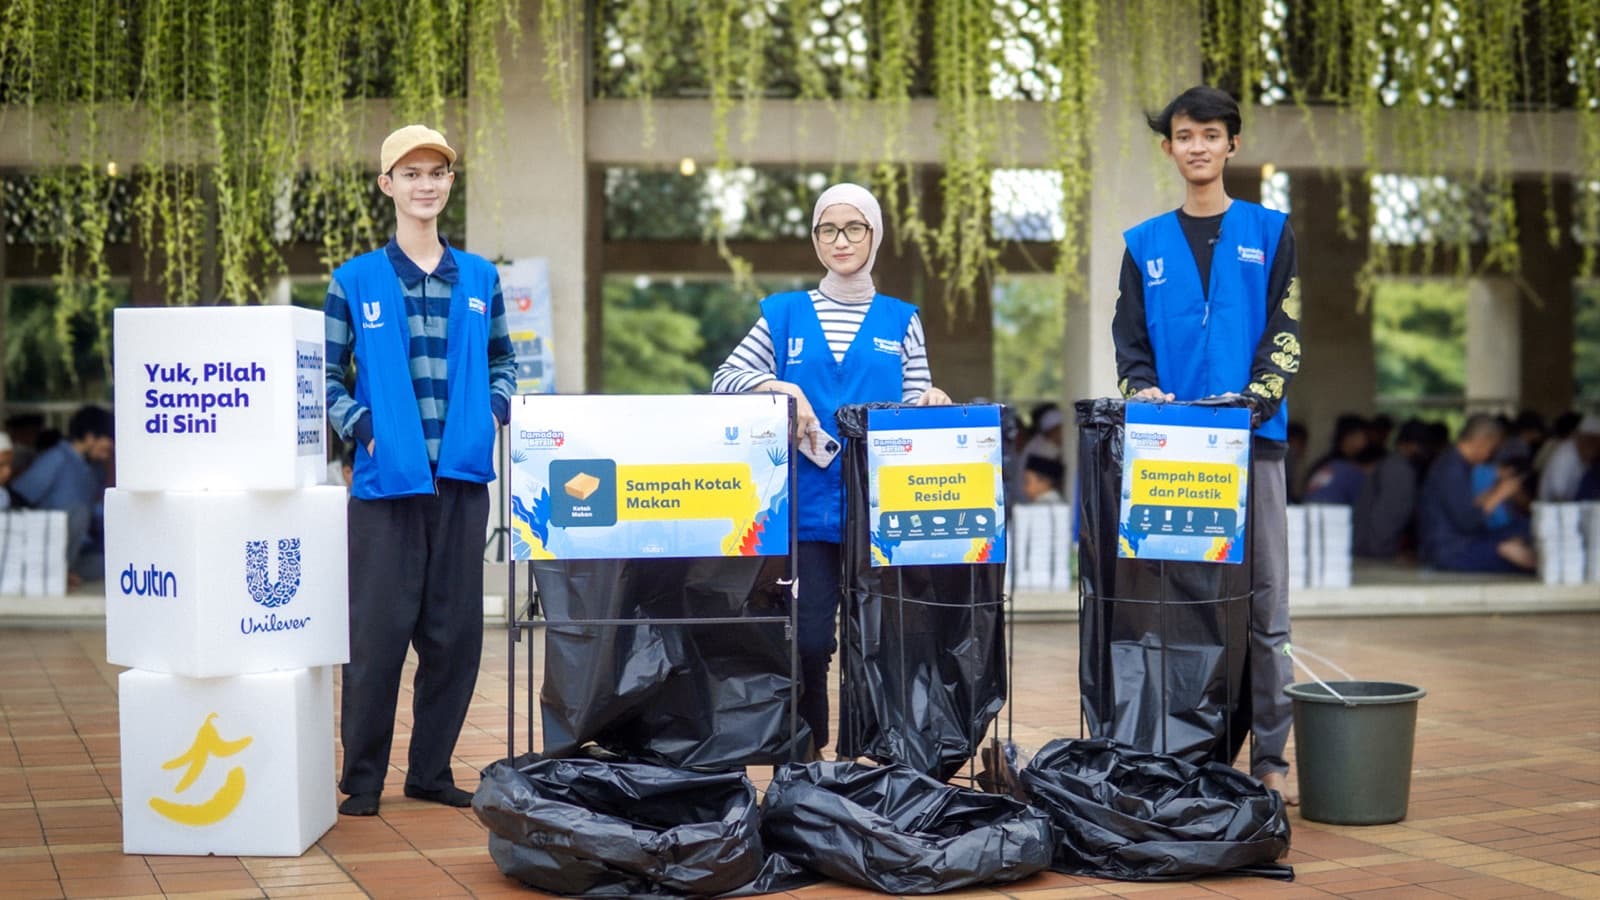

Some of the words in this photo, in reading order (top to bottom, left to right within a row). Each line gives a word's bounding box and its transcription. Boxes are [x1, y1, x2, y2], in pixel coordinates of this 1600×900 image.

[144, 362, 198, 385] Yuk,
[203, 362, 266, 382] Pilah
[145, 388, 250, 412] Sampah
[145, 413, 168, 433] di
[173, 413, 217, 433] Sini
[520, 430, 564, 439] Ramadan
[907, 473, 966, 487] Sampah
[1140, 469, 1195, 483] Sampah
[1198, 472, 1232, 484] Botol
[626, 478, 691, 493] Sampah
[695, 477, 742, 490] Kotak
[914, 490, 961, 502] Residu
[1149, 486, 1174, 497] dan
[1178, 488, 1222, 500] Plastik
[626, 497, 681, 509] Makan
[121, 563, 177, 597] duitin
[241, 614, 311, 634] Unilever
